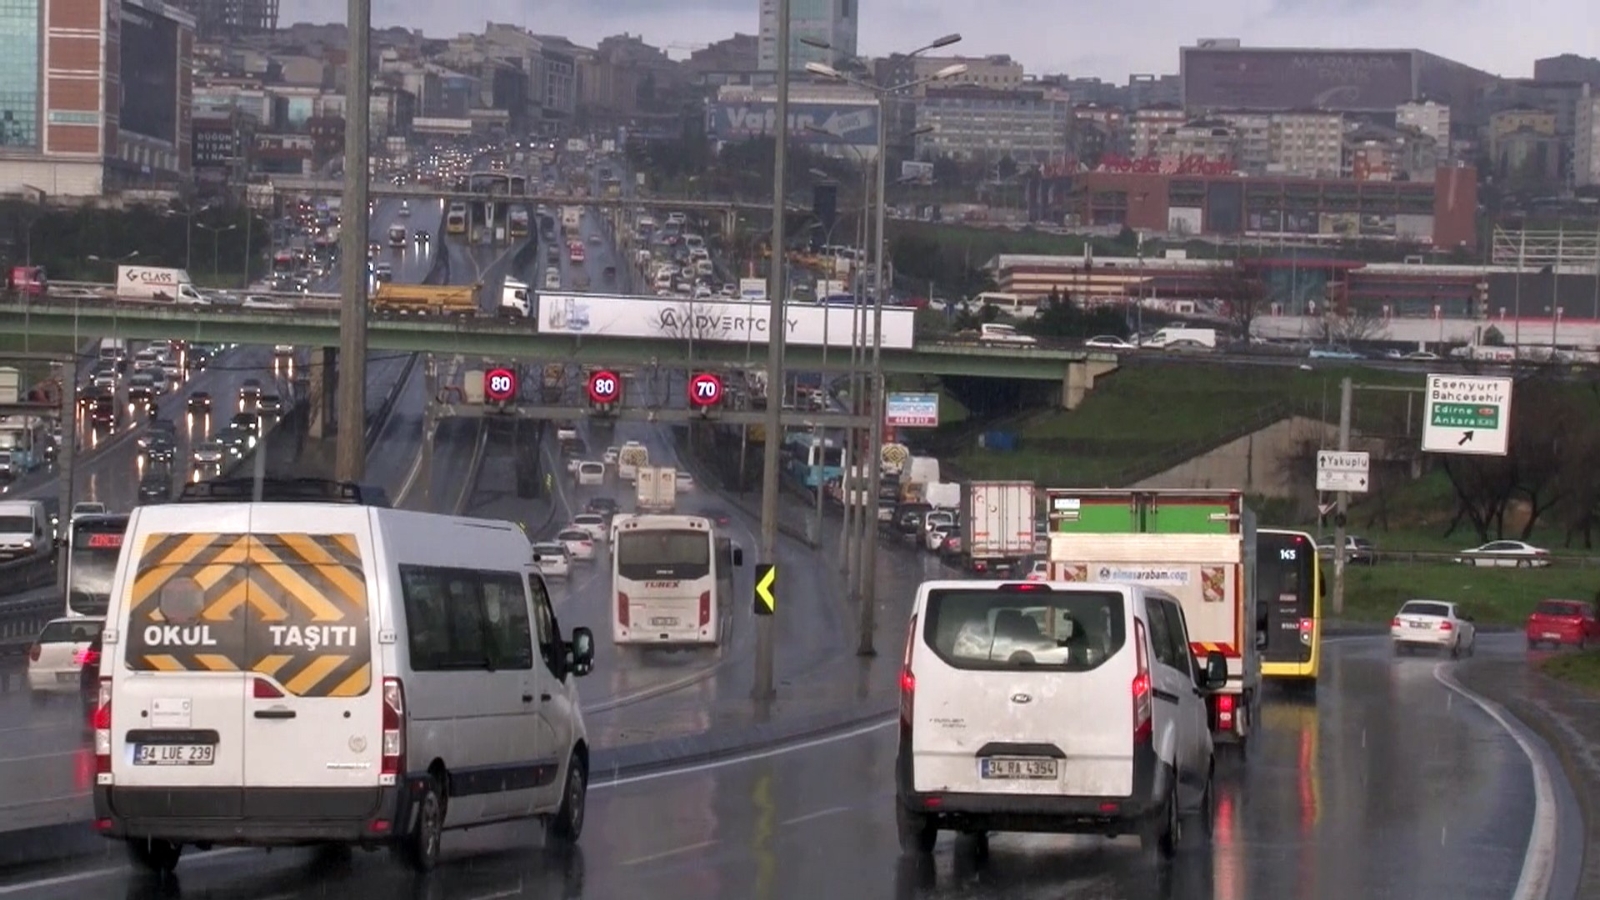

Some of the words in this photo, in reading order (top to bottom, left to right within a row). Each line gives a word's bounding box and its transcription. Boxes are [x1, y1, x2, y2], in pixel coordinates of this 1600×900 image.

[140, 271, 172, 282] CLASS
[681, 314, 798, 333] ADVERTCY
[491, 376, 511, 391] 80
[595, 379, 615, 394] 80
[697, 381, 716, 396] 70
[1433, 378, 1499, 392] Esenyurt
[1432, 390, 1504, 403] Bahçeşehir
[1434, 405, 1473, 415] Edirne
[1433, 415, 1476, 426] Ankara
[1327, 455, 1368, 468] Yakuplu
[645, 581, 680, 589] TUREX
[144, 625, 217, 646] OKUL
[269, 626, 357, 650] TAŞITI
[142, 746, 156, 760] 34
[162, 746, 184, 760] LUE
[189, 746, 212, 760] 239
[990, 761, 1003, 774] 34
[1008, 761, 1021, 774] RA
[1027, 761, 1054, 775] 4354
